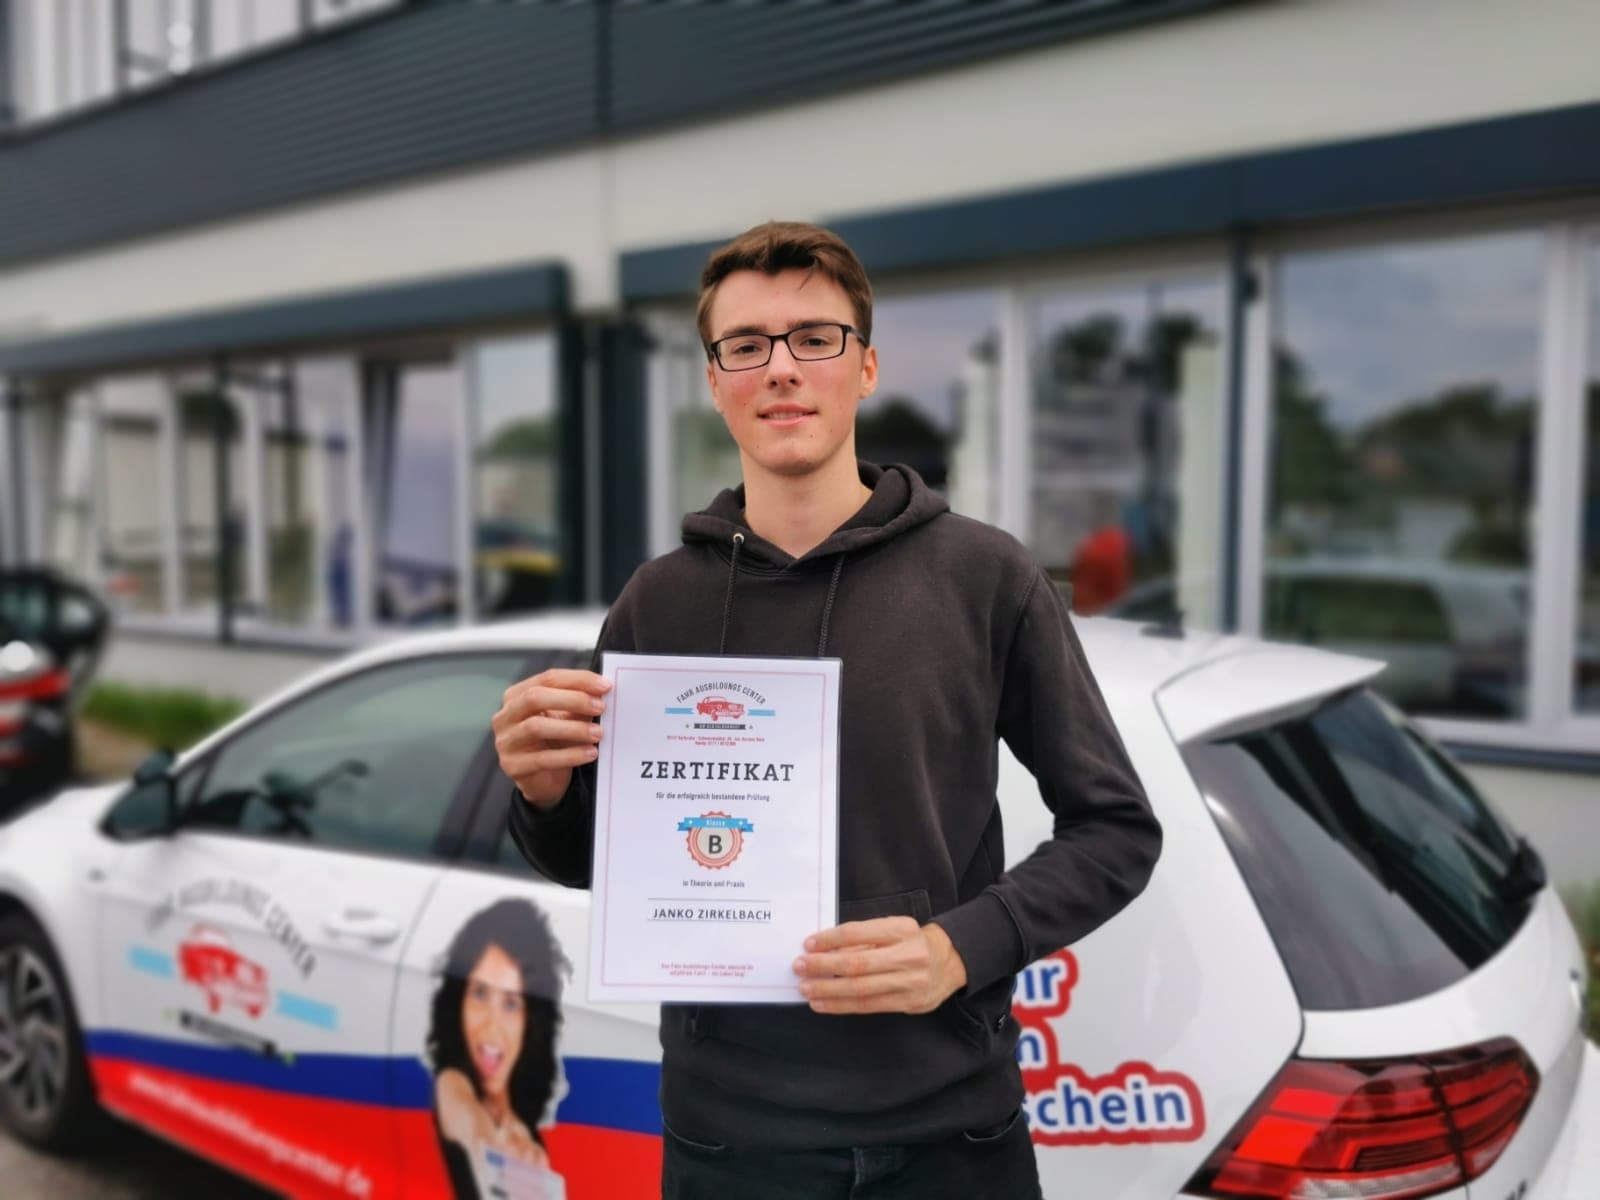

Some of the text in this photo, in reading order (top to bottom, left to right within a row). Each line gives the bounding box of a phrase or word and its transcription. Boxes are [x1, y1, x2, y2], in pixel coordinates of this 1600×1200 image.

[742, 686, 766, 705] CENTER
[640, 761, 794, 781] ZERTIFIKAT
[656, 791, 770, 802] für die erfolgreich bestandene Prüfung
[708, 834, 723, 854] B
[690, 879, 712, 887] Theorie
[713, 880, 725, 888] und
[726, 880, 745, 888] Praxis
[653, 908, 772, 921] JANKO ZIRKELBACH
